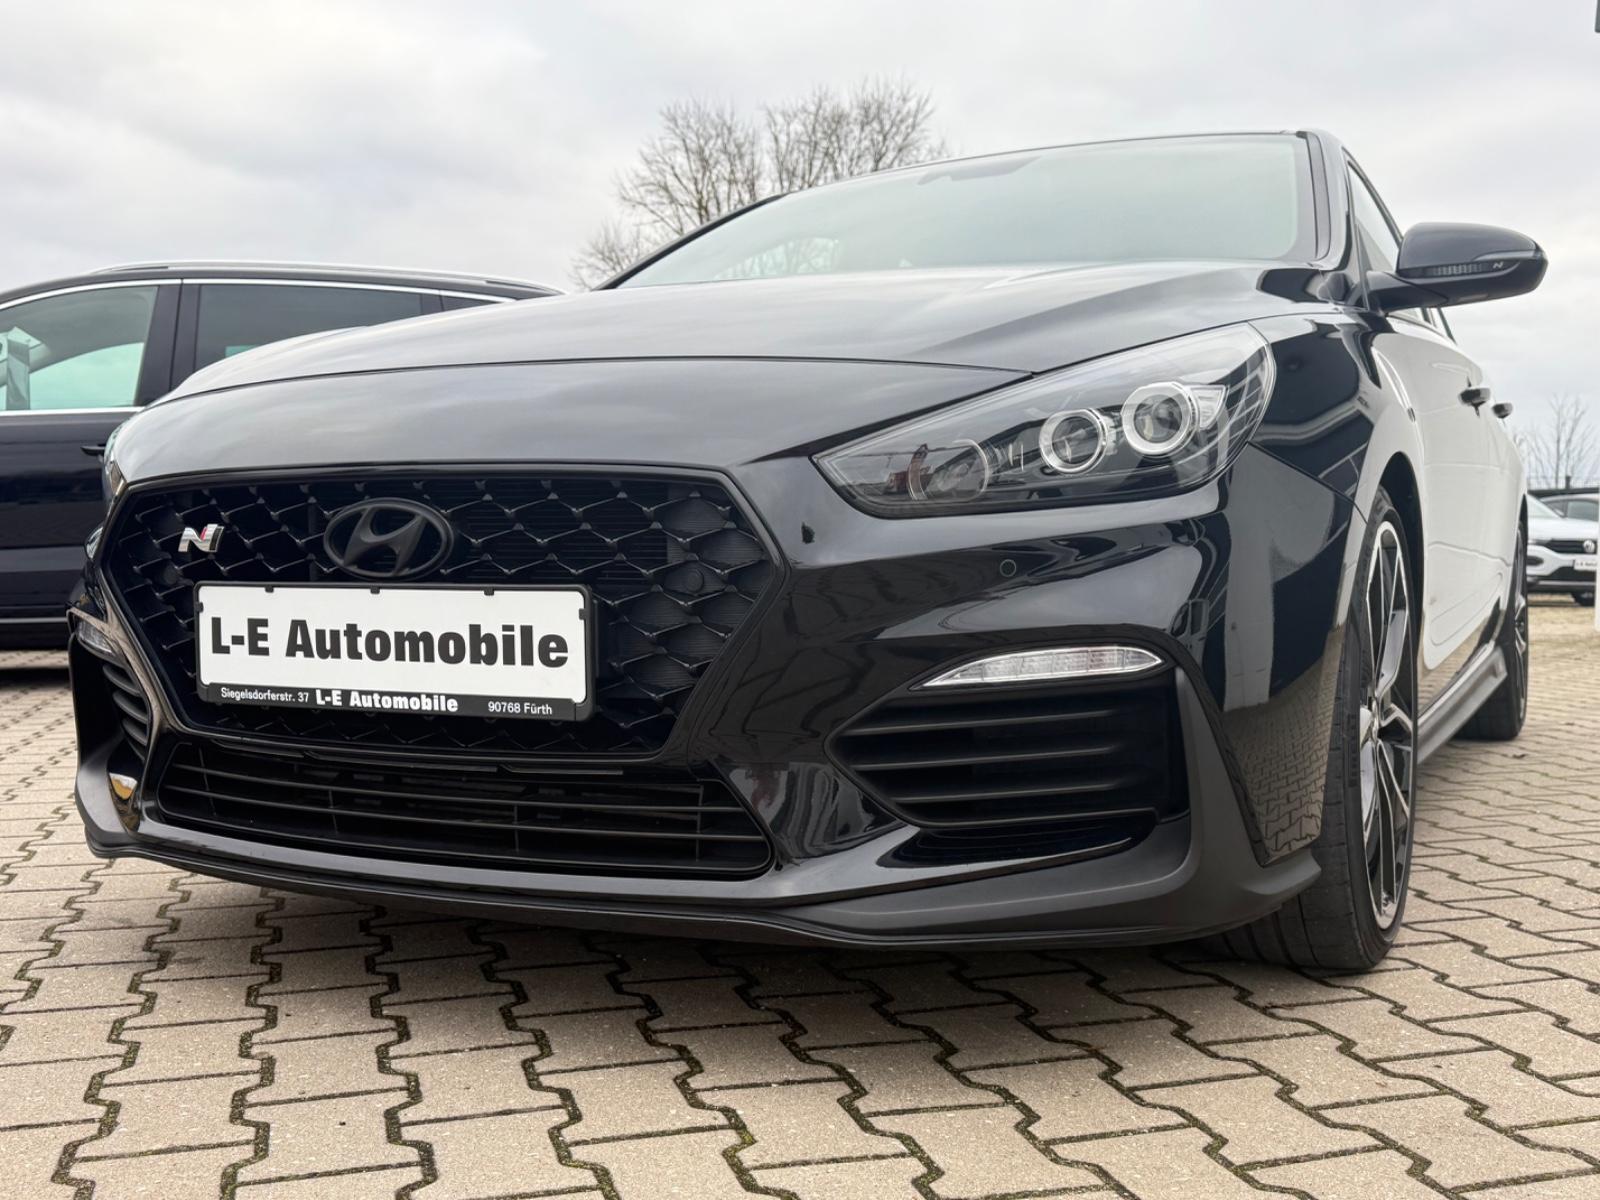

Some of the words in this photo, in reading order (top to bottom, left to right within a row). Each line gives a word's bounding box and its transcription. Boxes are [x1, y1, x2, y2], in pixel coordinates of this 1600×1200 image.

[211, 616, 270, 656] L-E
[285, 619, 569, 668] Automobile
[221, 687, 295, 702] Siegelsdorferstr.
[298, 692, 309, 702] 37
[315, 689, 343, 706] L-E
[349, 691, 458, 712] Automobile
[488, 701, 521, 714] 90768
[524, 702, 553, 715] Fürth
